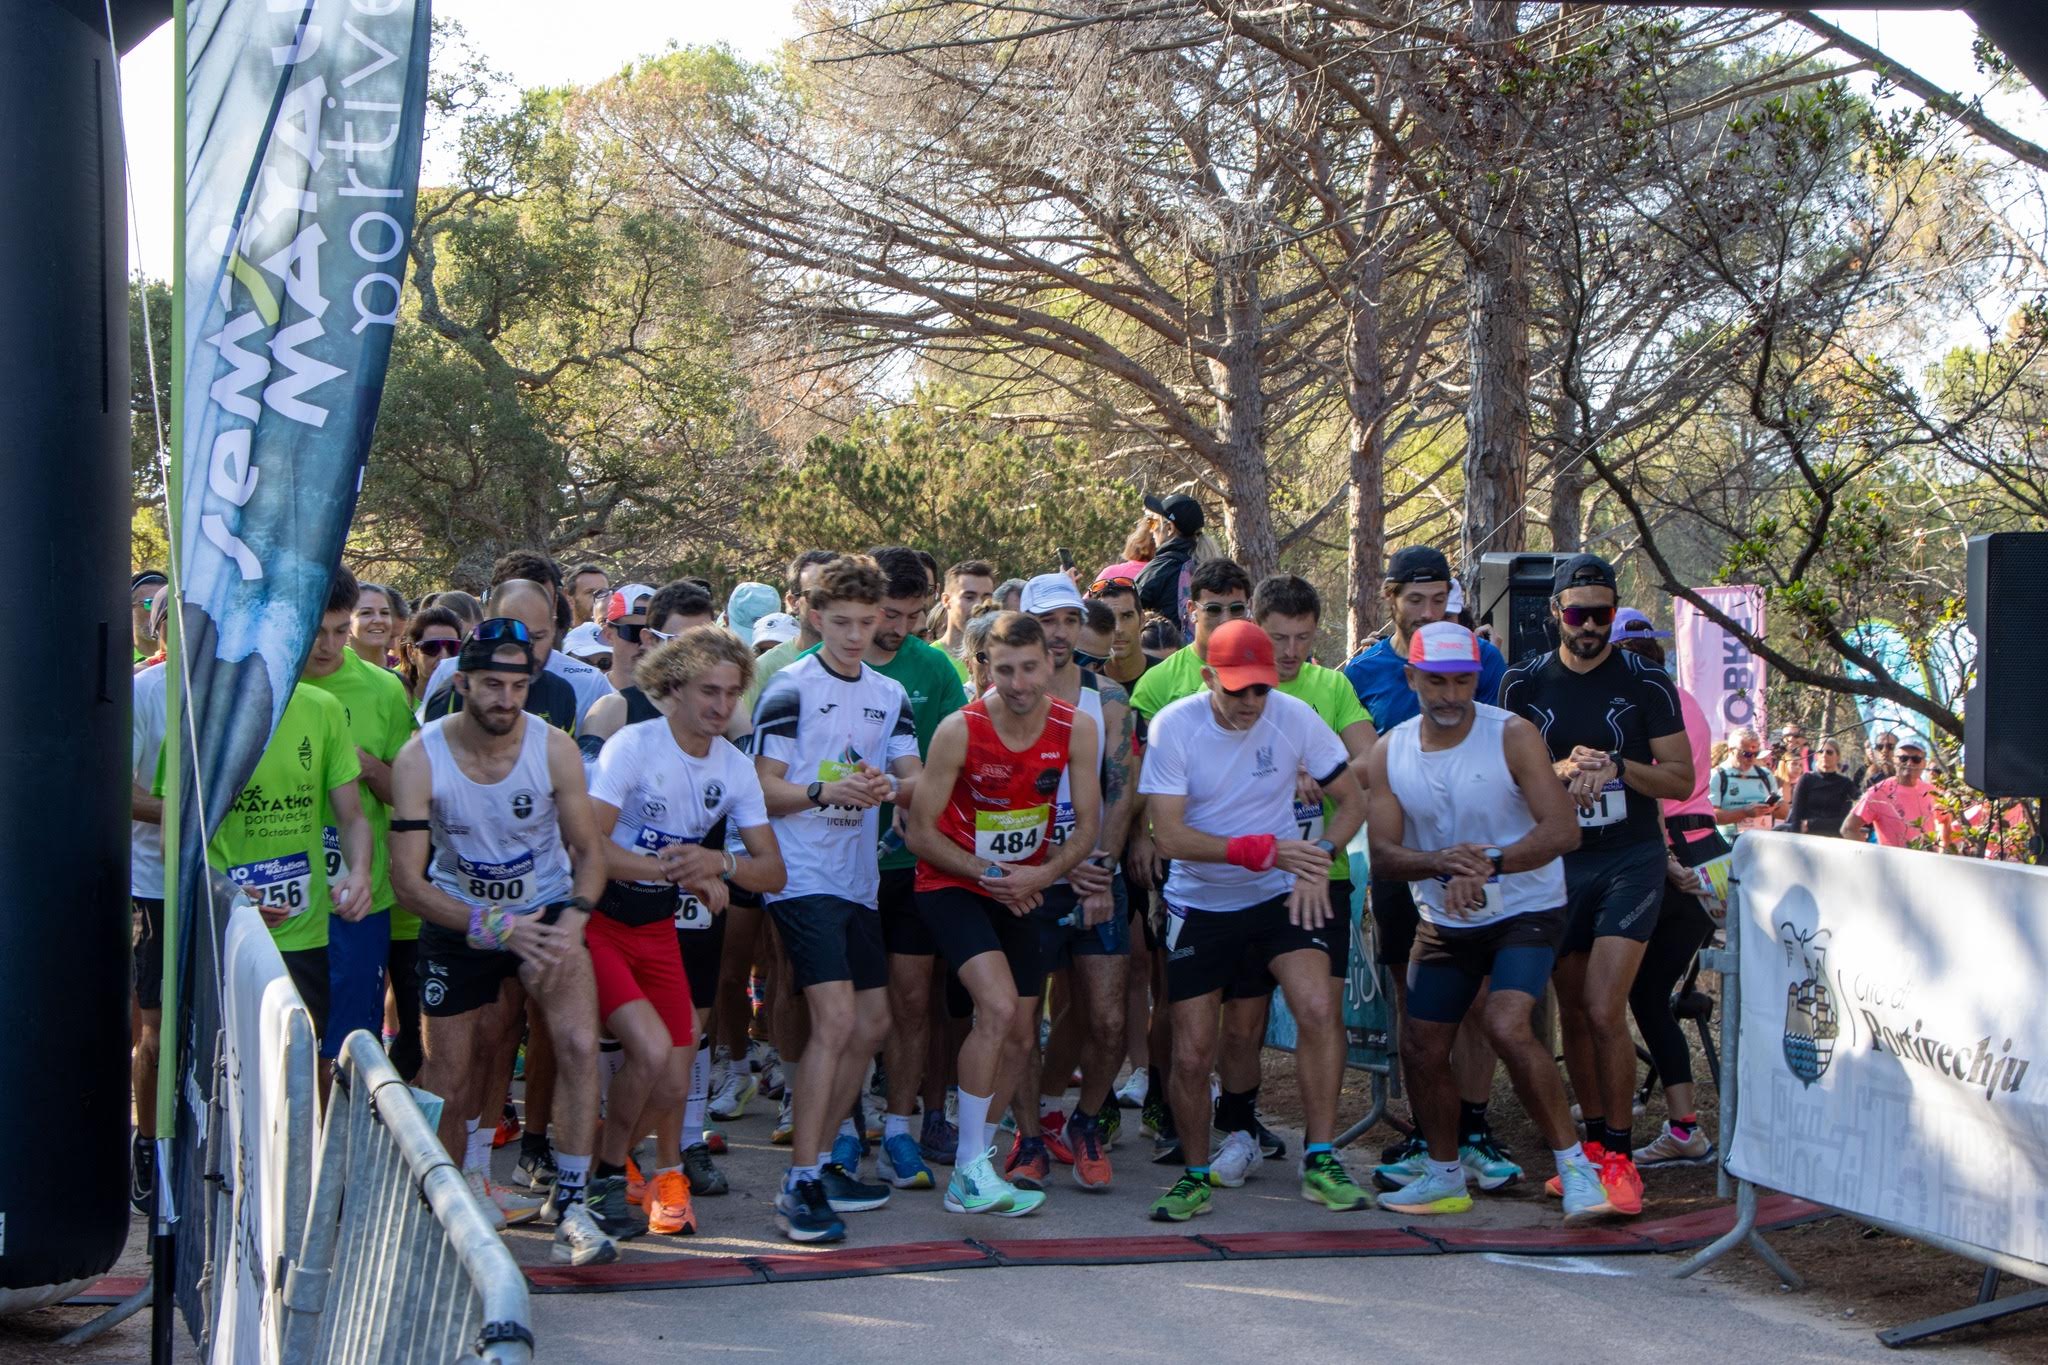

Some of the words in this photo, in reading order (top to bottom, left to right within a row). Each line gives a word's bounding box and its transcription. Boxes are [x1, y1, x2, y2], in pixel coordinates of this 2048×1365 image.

[990, 828, 1038, 855] 484
[230, 866, 249, 881] 10
[469, 879, 523, 900] 800
[1859, 1011, 2030, 1102] Portivechju
